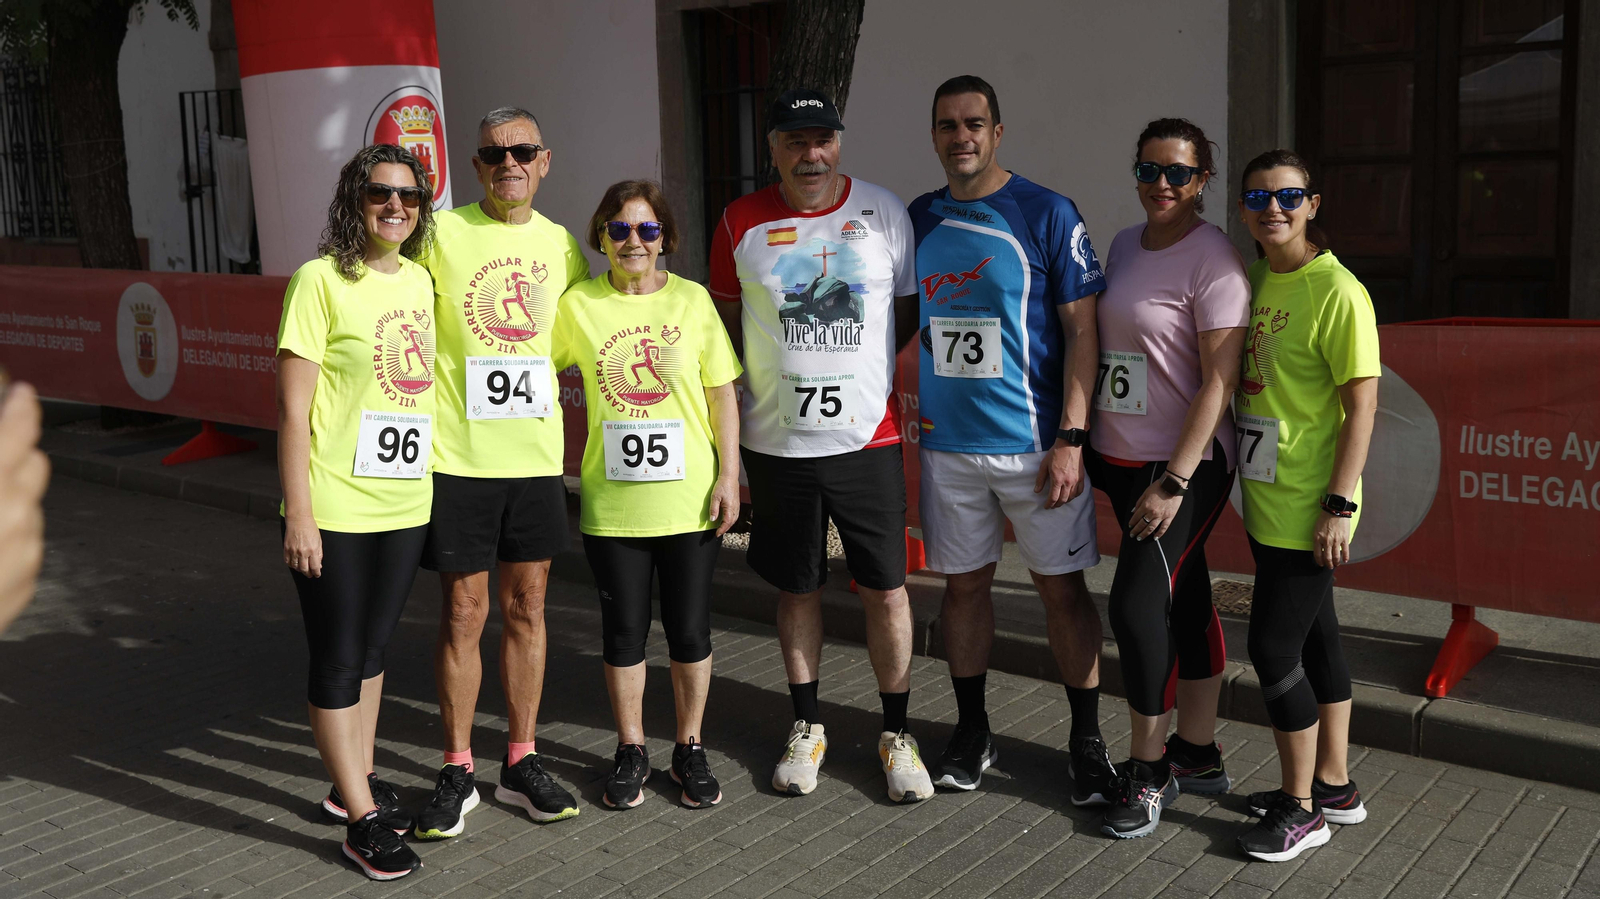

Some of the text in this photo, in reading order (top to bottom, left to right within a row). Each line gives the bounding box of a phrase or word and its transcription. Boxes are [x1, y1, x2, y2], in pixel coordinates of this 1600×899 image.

[791, 99, 824, 109] Jeep
[968, 210, 995, 223] PADEL
[921, 256, 995, 303] TAX
[464, 257, 522, 354] VII CARRERA POPULAR
[936, 288, 971, 305] SAN ROQUE
[12, 311, 54, 328] Ayuntamiento
[55, 315, 64, 328] de
[64, 315, 78, 330] San
[78, 316, 101, 335] Roque
[491, 328, 532, 341] PUENTE MAYORGA
[783, 318, 861, 345] Vive la vida
[37, 334, 46, 348] DE
[47, 334, 84, 352] DEPORTES
[181, 324, 275, 348] Ilustre Ayuntamiento de
[942, 331, 984, 364] 73
[183, 348, 238, 368] DELEGACIÓN
[239, 354, 252, 370] DE
[373, 309, 417, 407] VII CARRERA POPULAR
[788, 343, 803, 351] Cruz
[805, 343, 813, 351] de
[824, 344, 858, 354] Esperanza
[596, 325, 651, 418] VII CARRERA POPULAR
[789, 375, 810, 383] CARRERA
[1098, 363, 1130, 399] 76
[486, 370, 535, 405] 94
[622, 395, 664, 405] PUENTE MAYORGA
[795, 386, 842, 417] 75
[373, 414, 396, 422] CARRERA
[637, 422, 664, 430] SOLIDARIA
[1261, 420, 1276, 428] APRON
[377, 427, 420, 464] 96
[621, 433, 669, 468] 95
[1459, 425, 1552, 460] Ilustre
